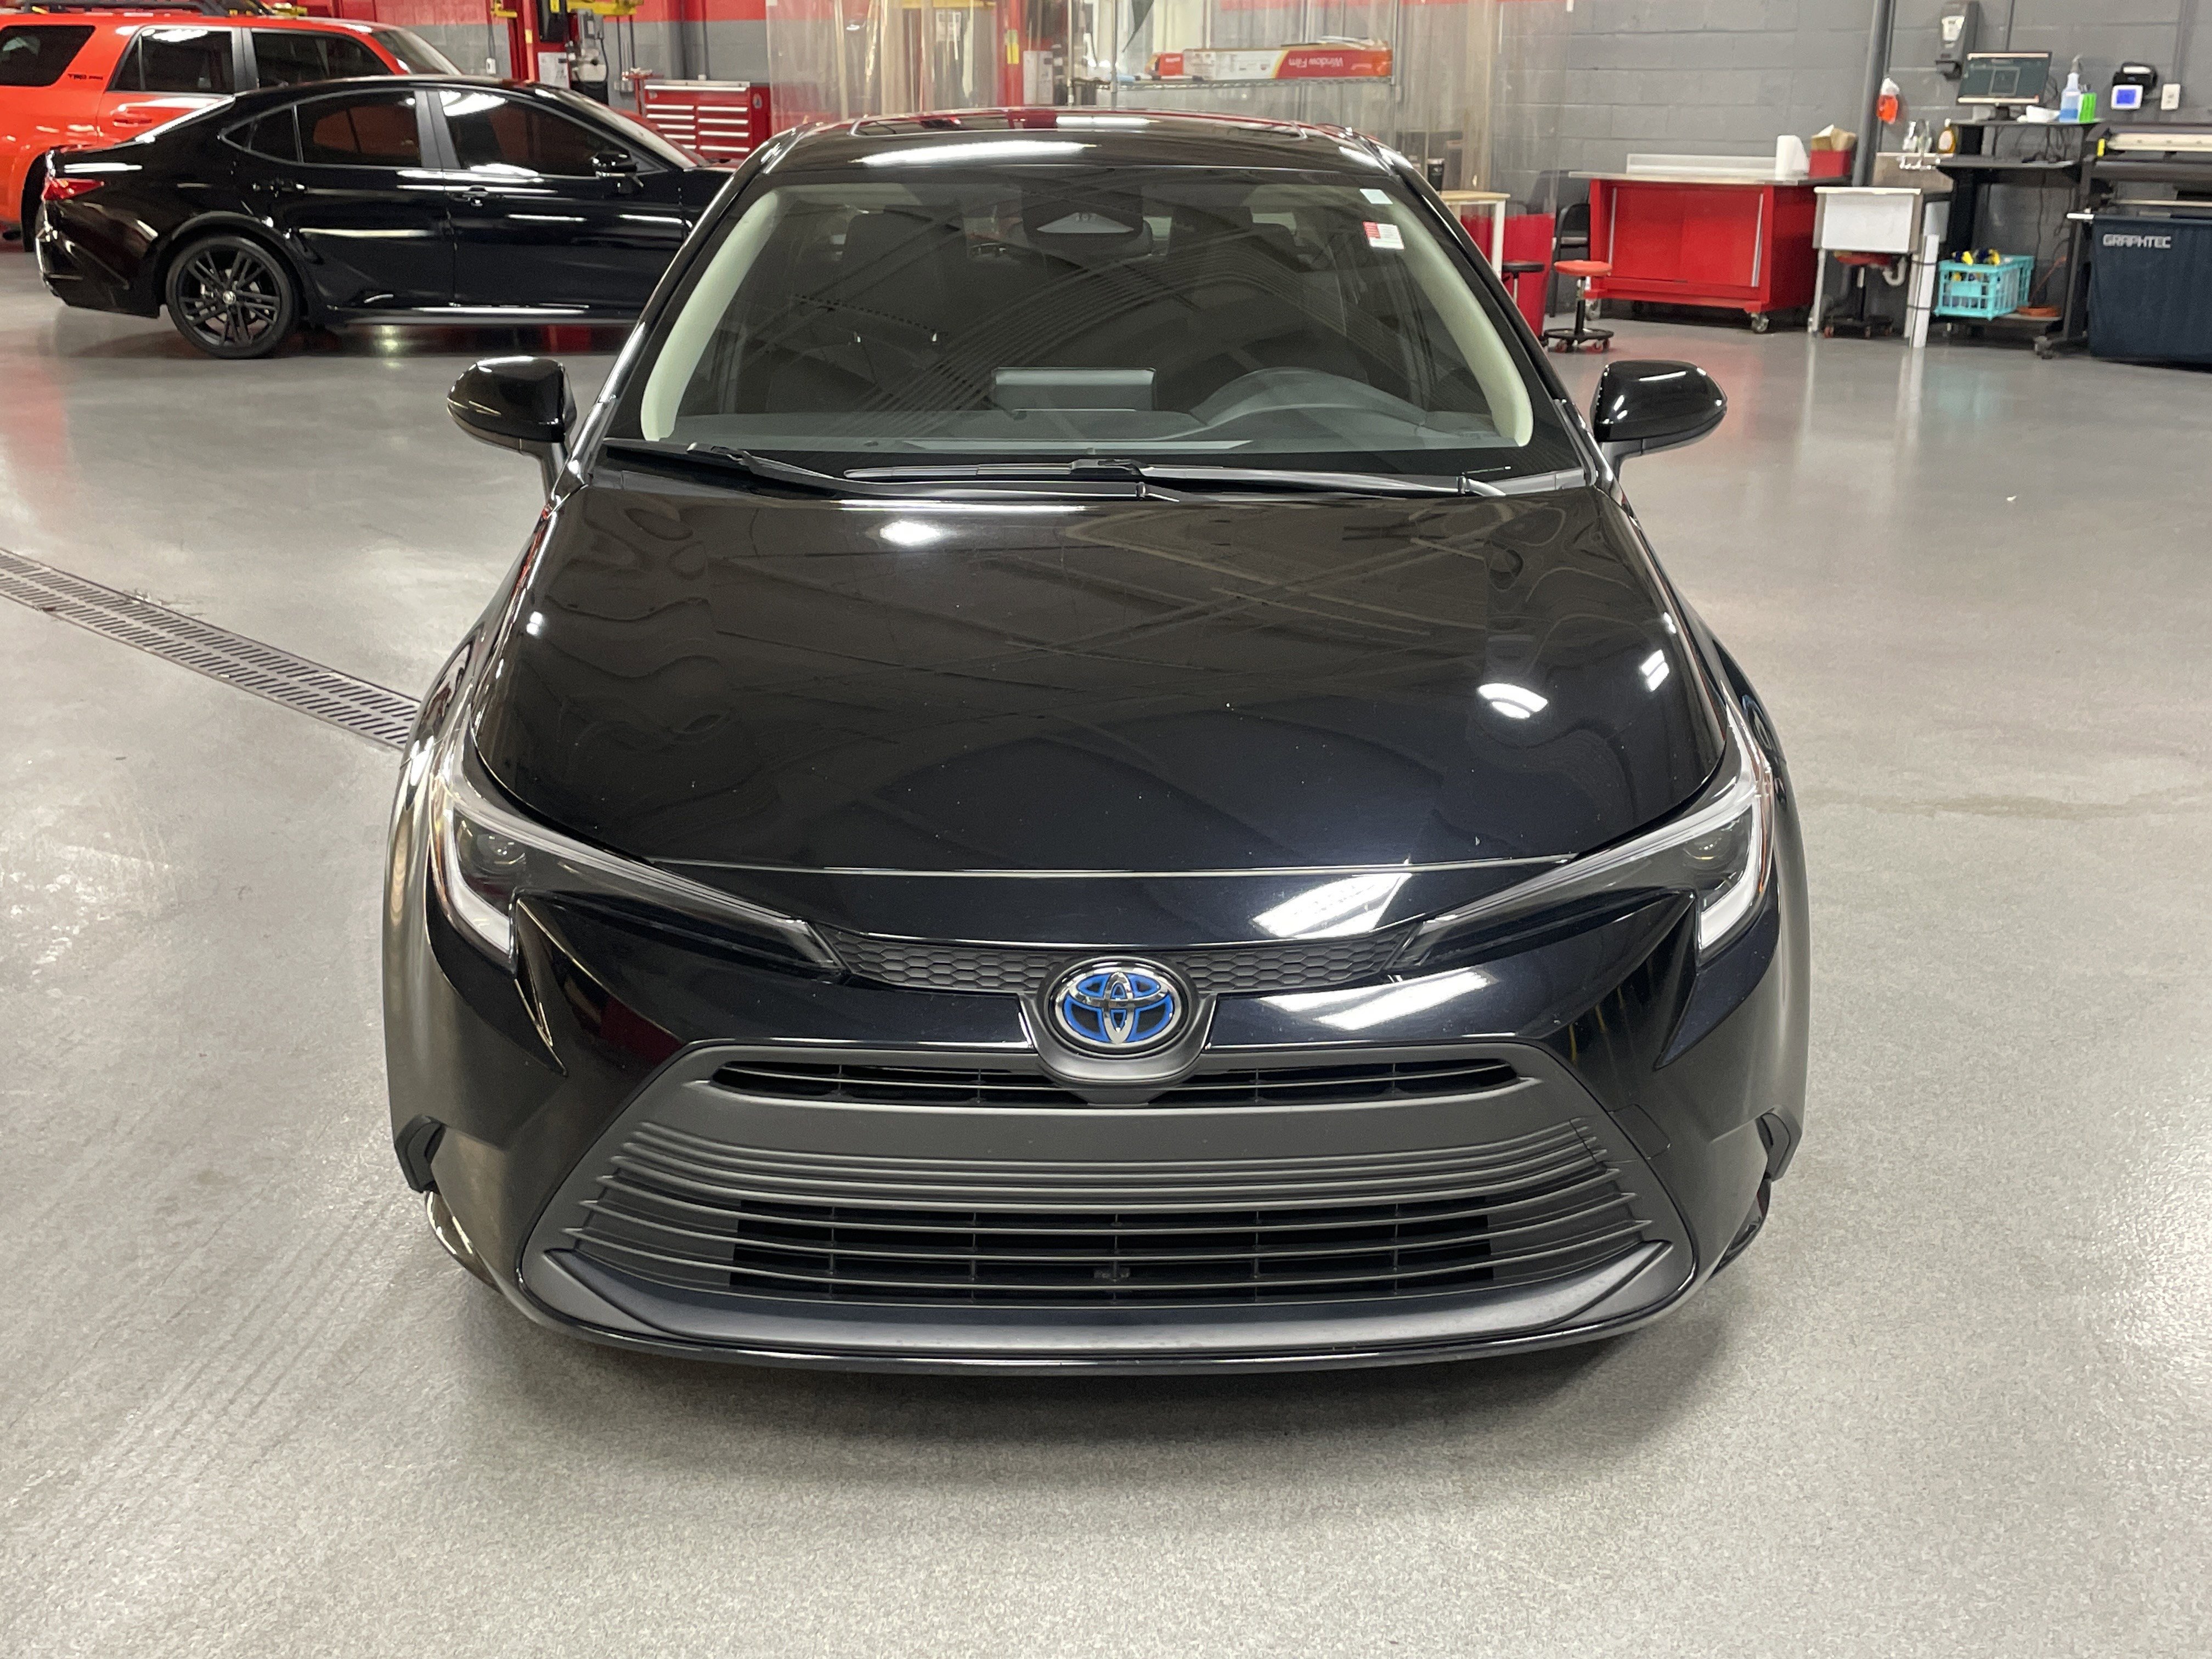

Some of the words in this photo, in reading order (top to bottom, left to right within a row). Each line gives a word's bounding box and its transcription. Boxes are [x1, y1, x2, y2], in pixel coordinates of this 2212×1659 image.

[1288, 58, 1307, 68] Film
[1308, 57, 1344, 67] Window
[2103, 234, 2171, 249] GRAPHTEC
